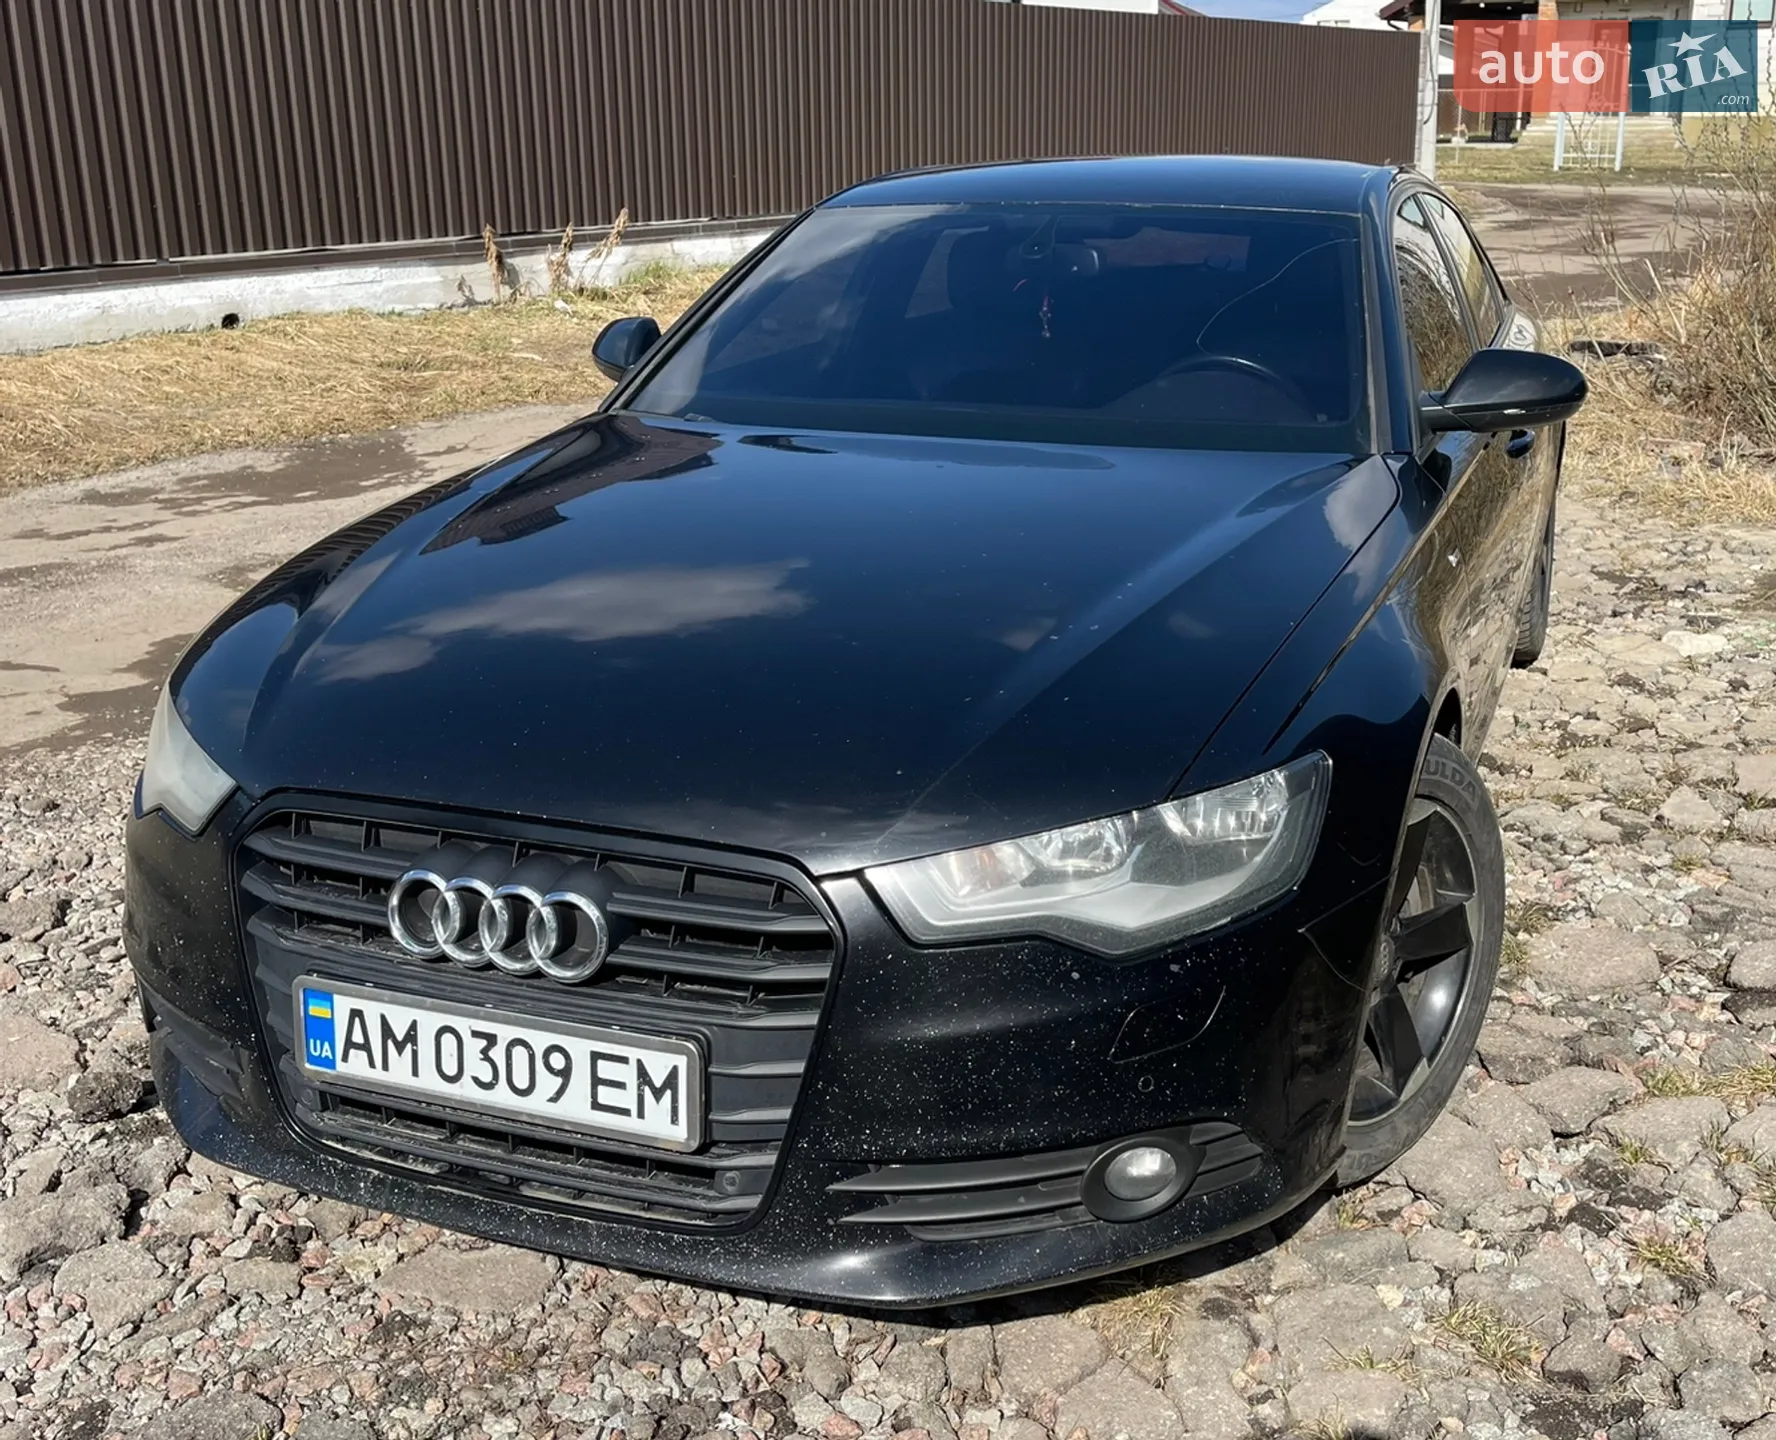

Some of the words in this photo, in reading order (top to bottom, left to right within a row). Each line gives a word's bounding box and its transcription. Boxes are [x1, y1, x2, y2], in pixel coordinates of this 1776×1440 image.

[1424, 758, 1476, 803] ULDA
[310, 1039, 333, 1060] UA
[341, 1008, 420, 1078] AM
[434, 1025, 574, 1103] 0309
[590, 1050, 680, 1127] EM
